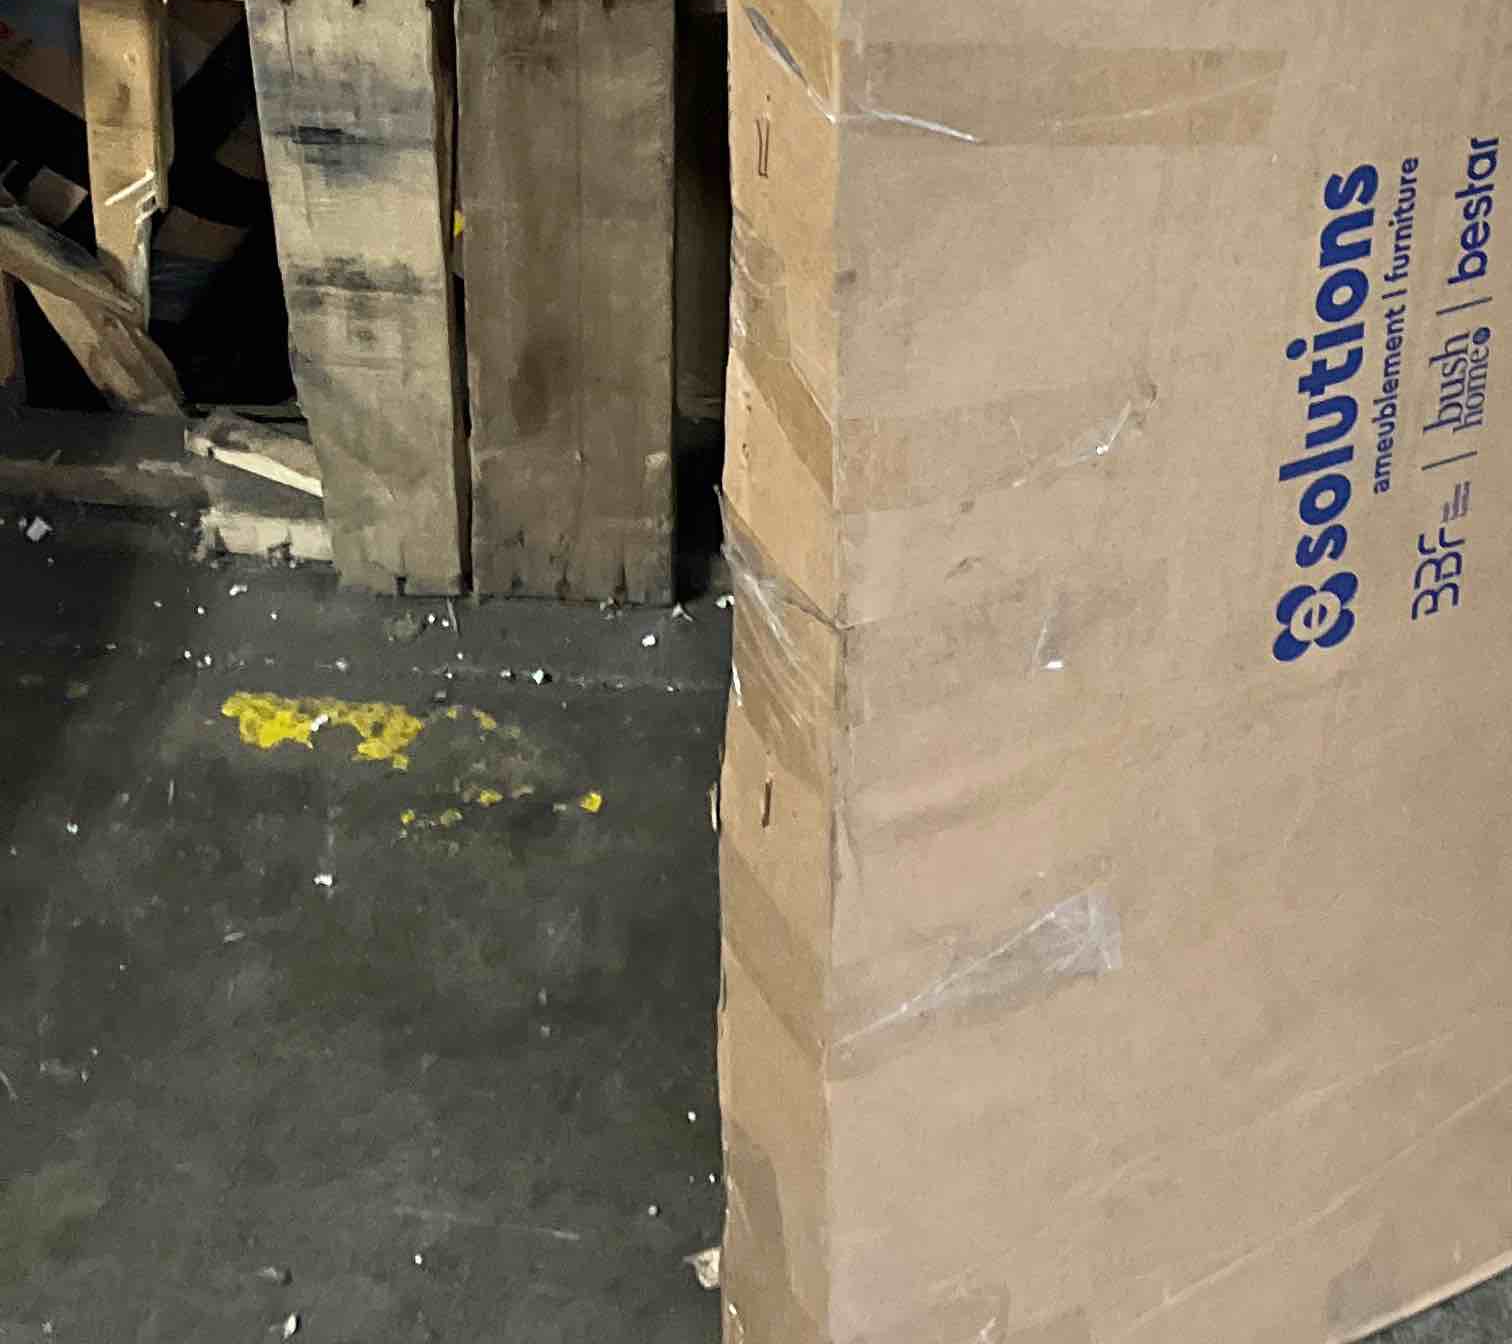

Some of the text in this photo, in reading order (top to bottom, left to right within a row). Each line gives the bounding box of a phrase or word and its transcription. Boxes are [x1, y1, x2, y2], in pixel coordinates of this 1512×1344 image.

[1374, 156, 1418, 494] ameublement furniture
[1448, 137, 1499, 284] bestar
[1279, 163, 1379, 568] solutions
[1423, 329, 1470, 432] bush
